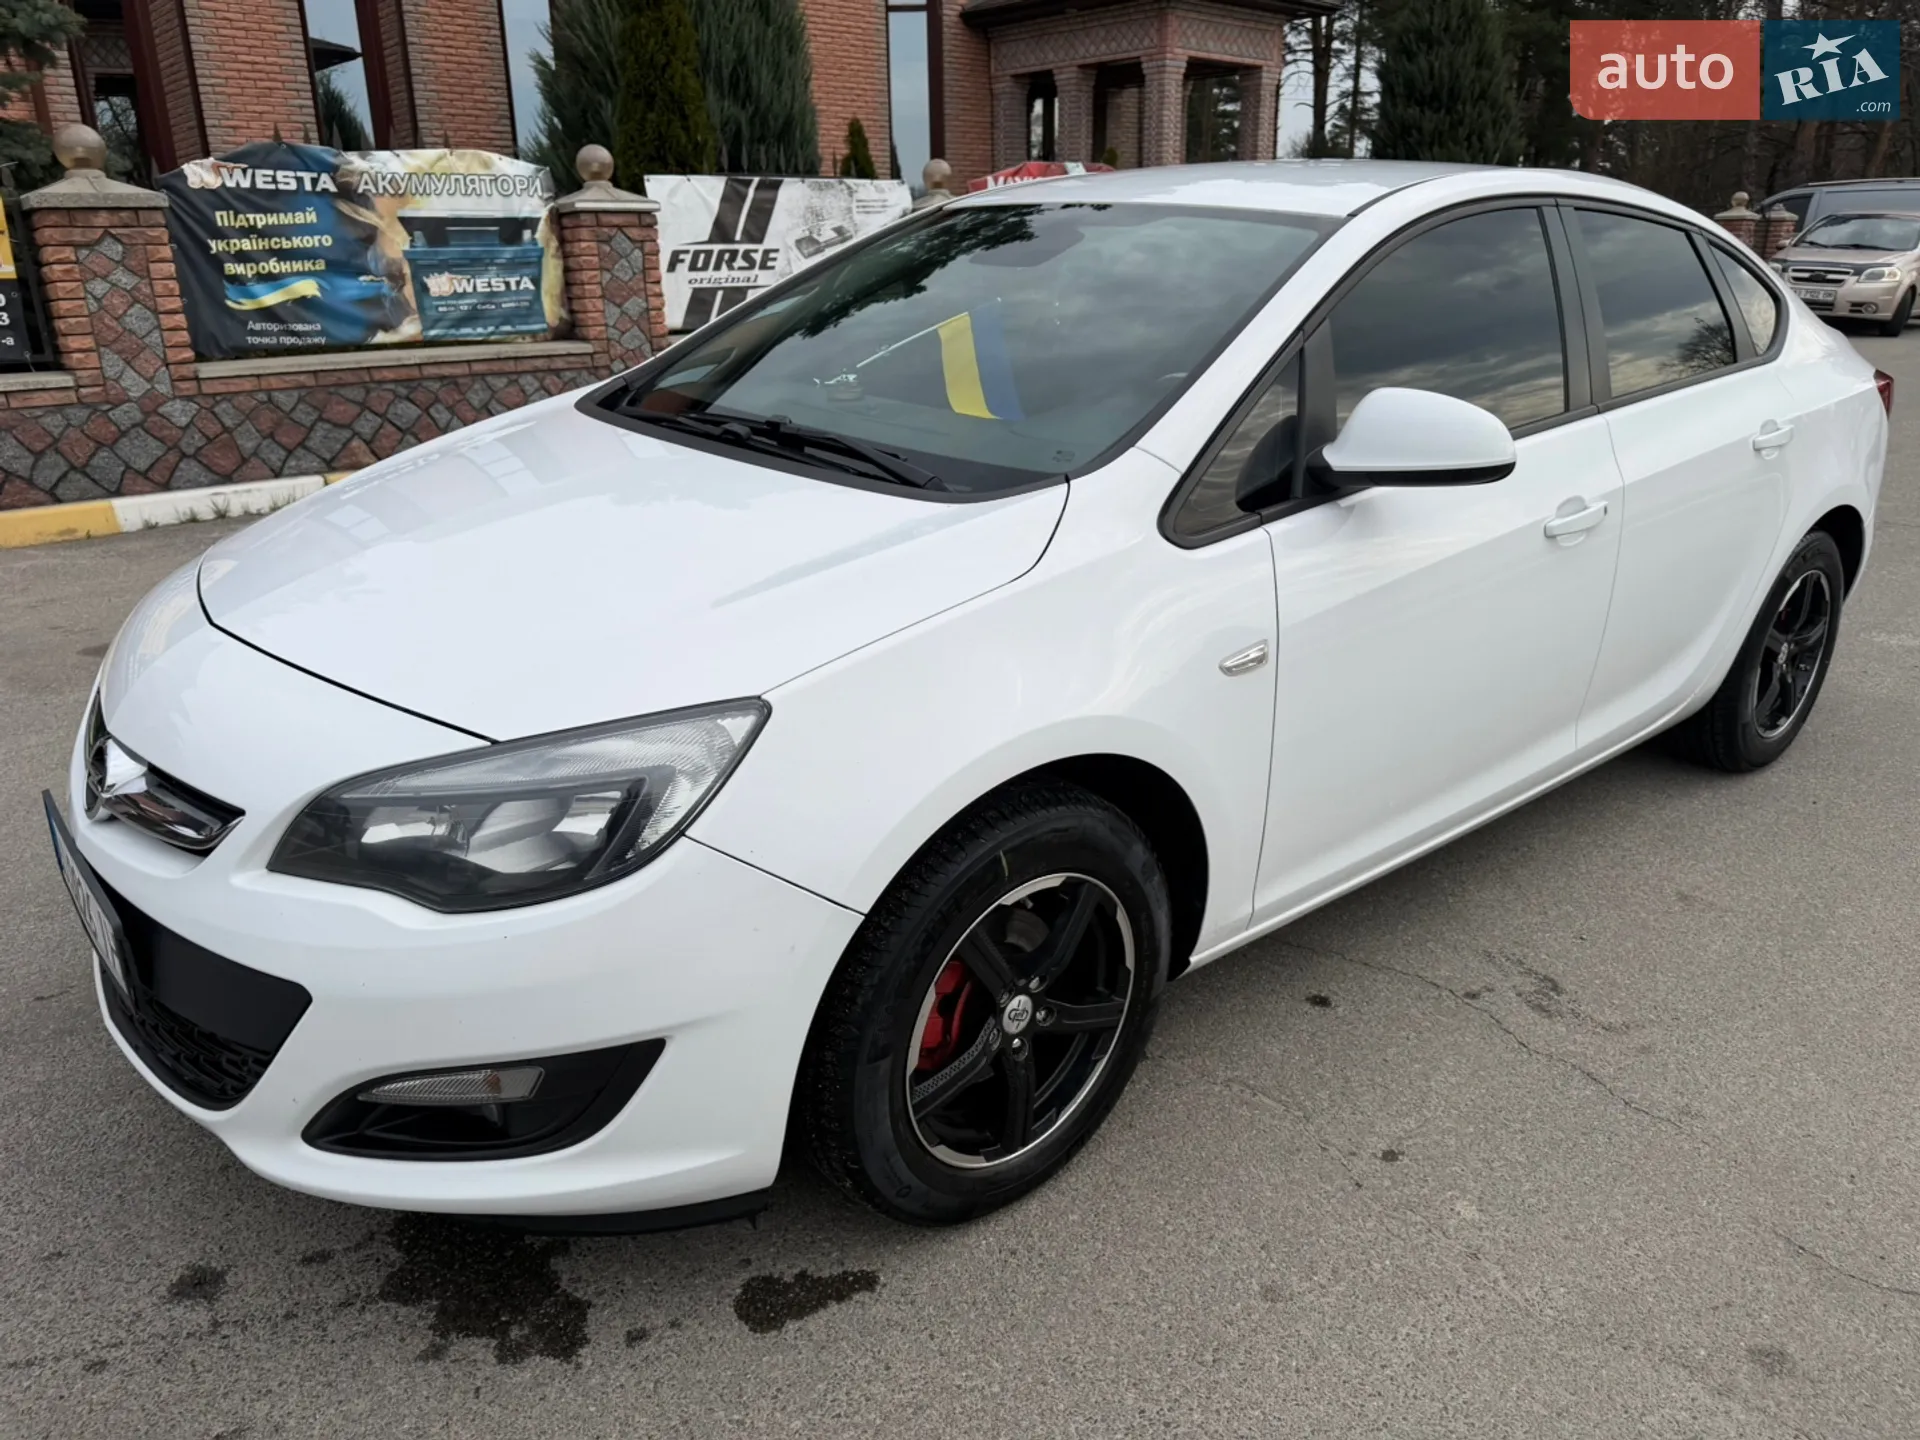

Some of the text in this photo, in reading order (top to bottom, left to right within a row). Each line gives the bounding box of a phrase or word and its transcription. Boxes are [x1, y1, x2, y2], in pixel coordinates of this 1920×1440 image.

[220, 168, 338, 193] WESTA
[356, 172, 545, 197] АКУМУЛЯТОРИ
[215, 207, 317, 229] Підтримай
[207, 234, 333, 254] українського
[223, 257, 326, 278] виробника
[666, 248, 780, 273] FORSE
[453, 276, 536, 293] WESTA
[688, 273, 759, 286] original
[246, 320, 322, 332] Авторизована
[246, 336, 327, 346] точка продажу
